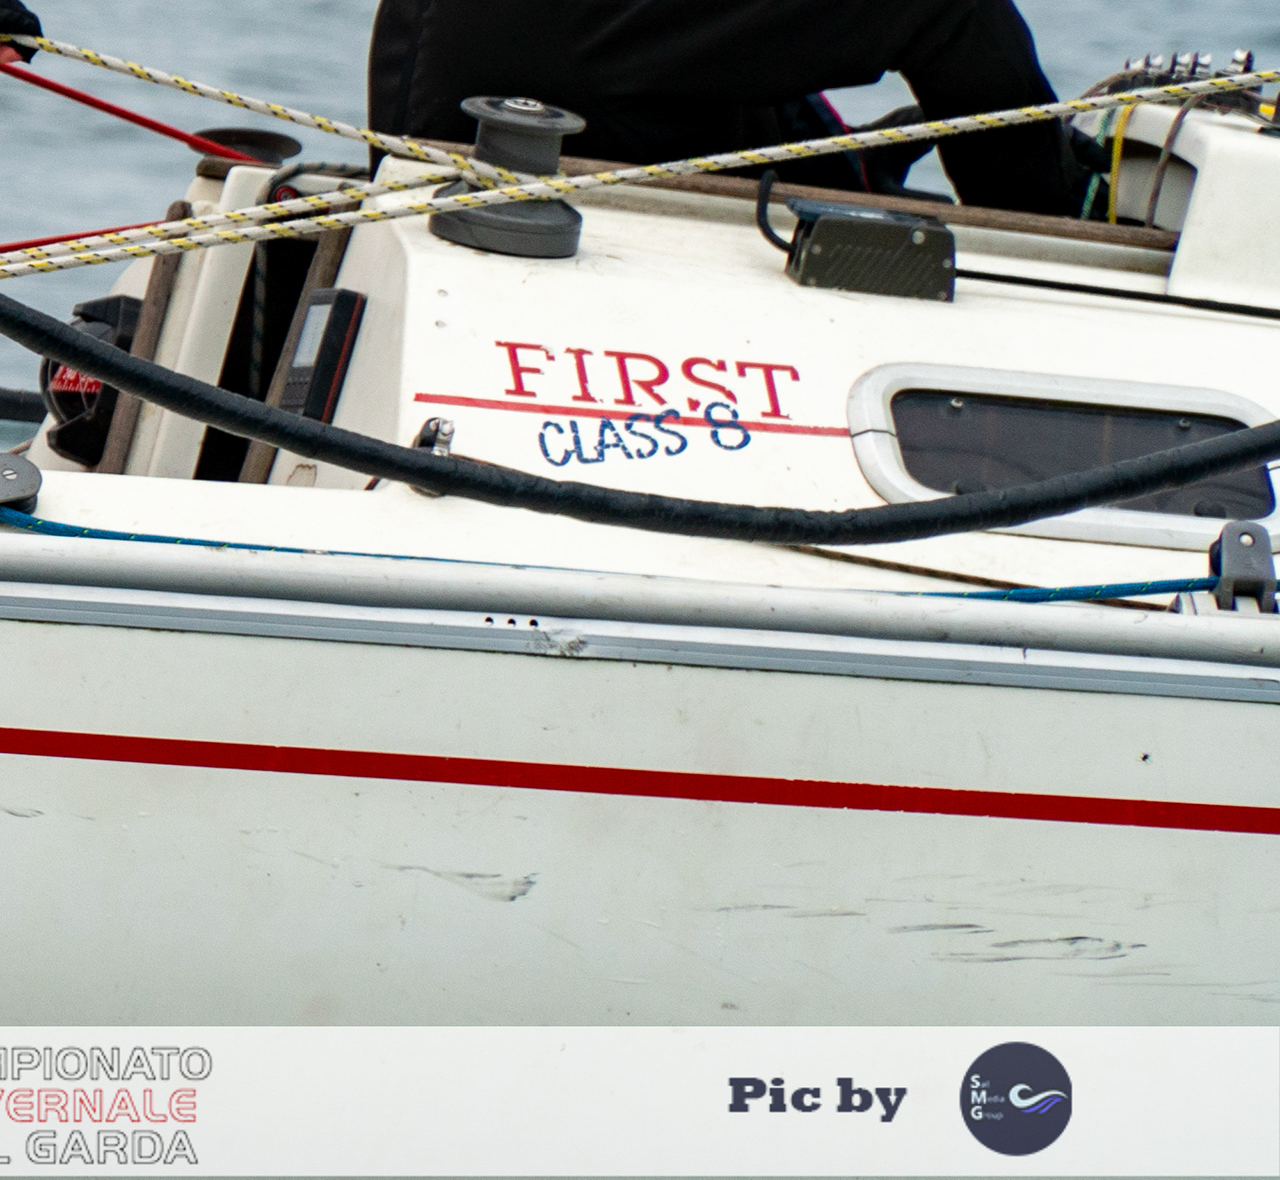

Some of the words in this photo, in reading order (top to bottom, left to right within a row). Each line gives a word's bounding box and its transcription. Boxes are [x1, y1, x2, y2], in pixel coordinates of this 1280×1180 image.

[495, 340, 800, 421] FIRST
[539, 409, 688, 466] CLASS
[704, 402, 751, 450] 8
